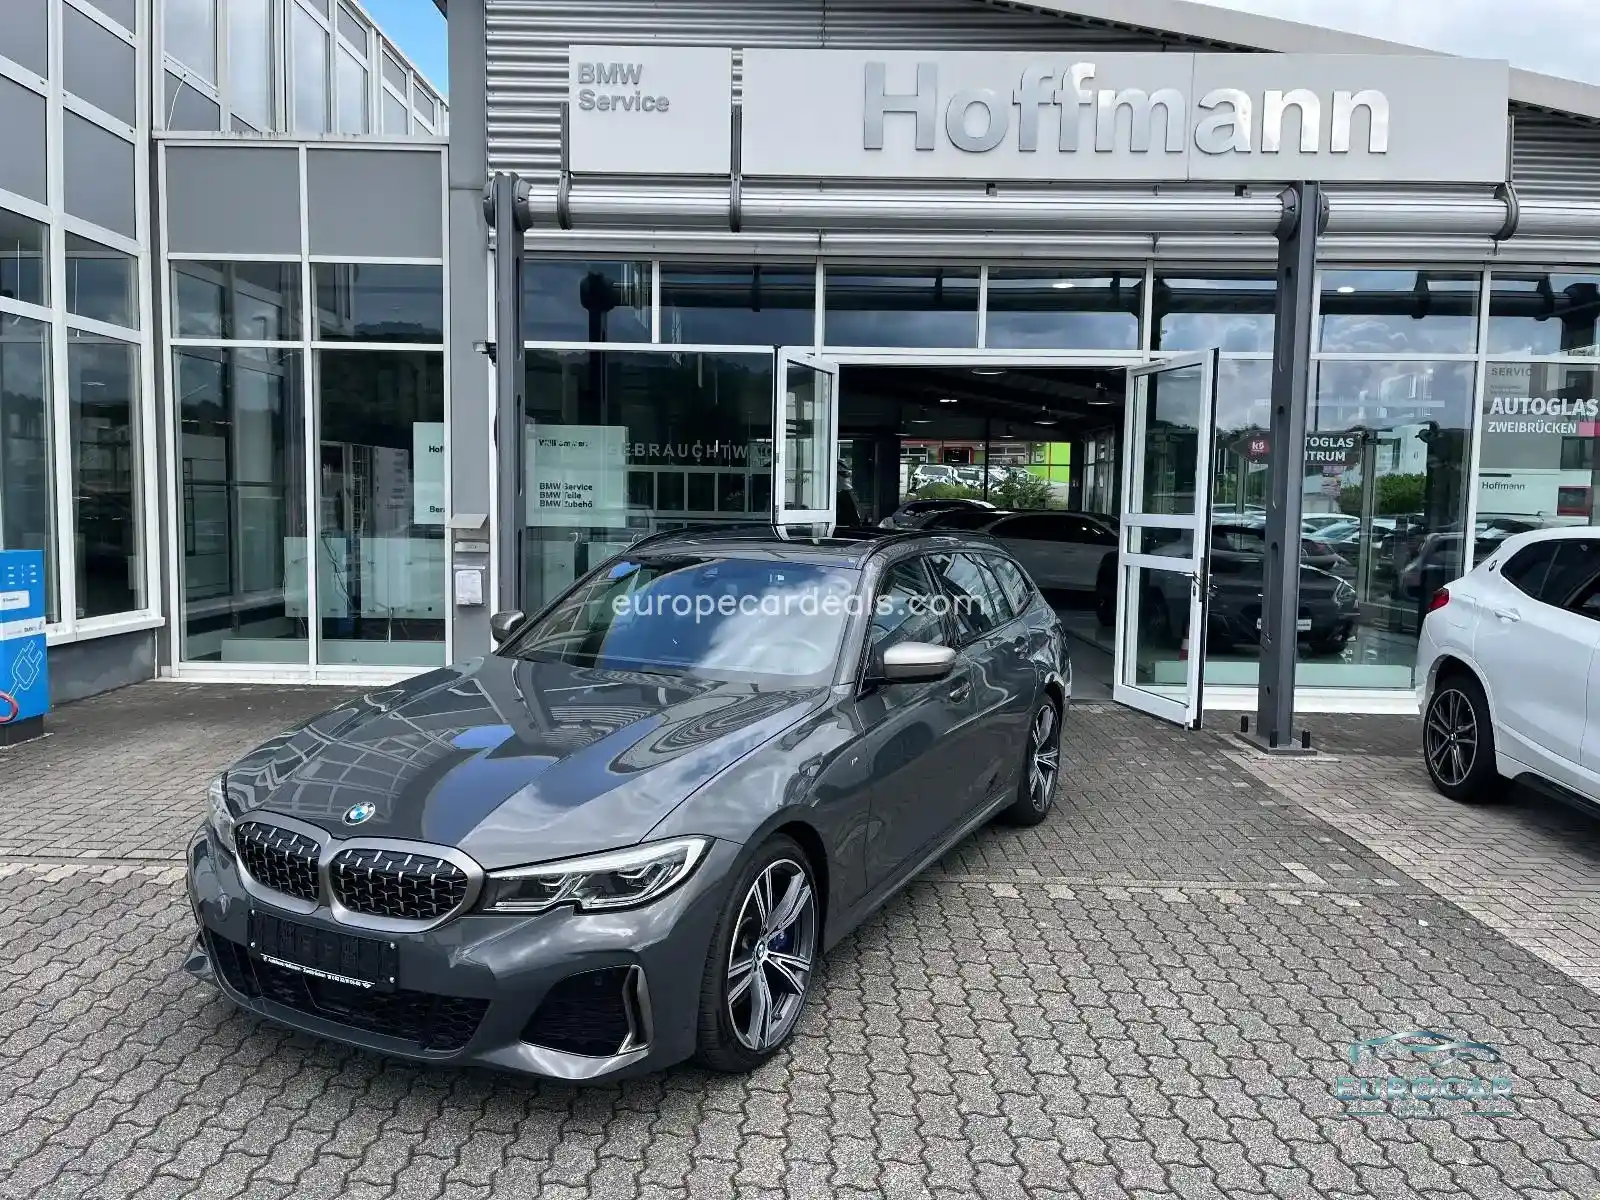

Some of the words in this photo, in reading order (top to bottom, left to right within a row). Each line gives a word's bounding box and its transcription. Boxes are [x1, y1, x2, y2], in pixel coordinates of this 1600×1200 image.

[577, 62, 642, 85] BMW
[578, 89, 669, 112] Service
[863, 61, 1389, 155] Hoffmann
[1489, 397, 1599, 417] AUTOGLAS
[1487, 419, 1577, 434] ZWEIBRÜCKEN
[539, 482, 561, 490] BMW
[563, 483, 593, 491] Service
[1481, 481, 1525, 490] Hoffmann
[539, 491, 561, 499] BMW
[429, 505, 446, 513] Ber
